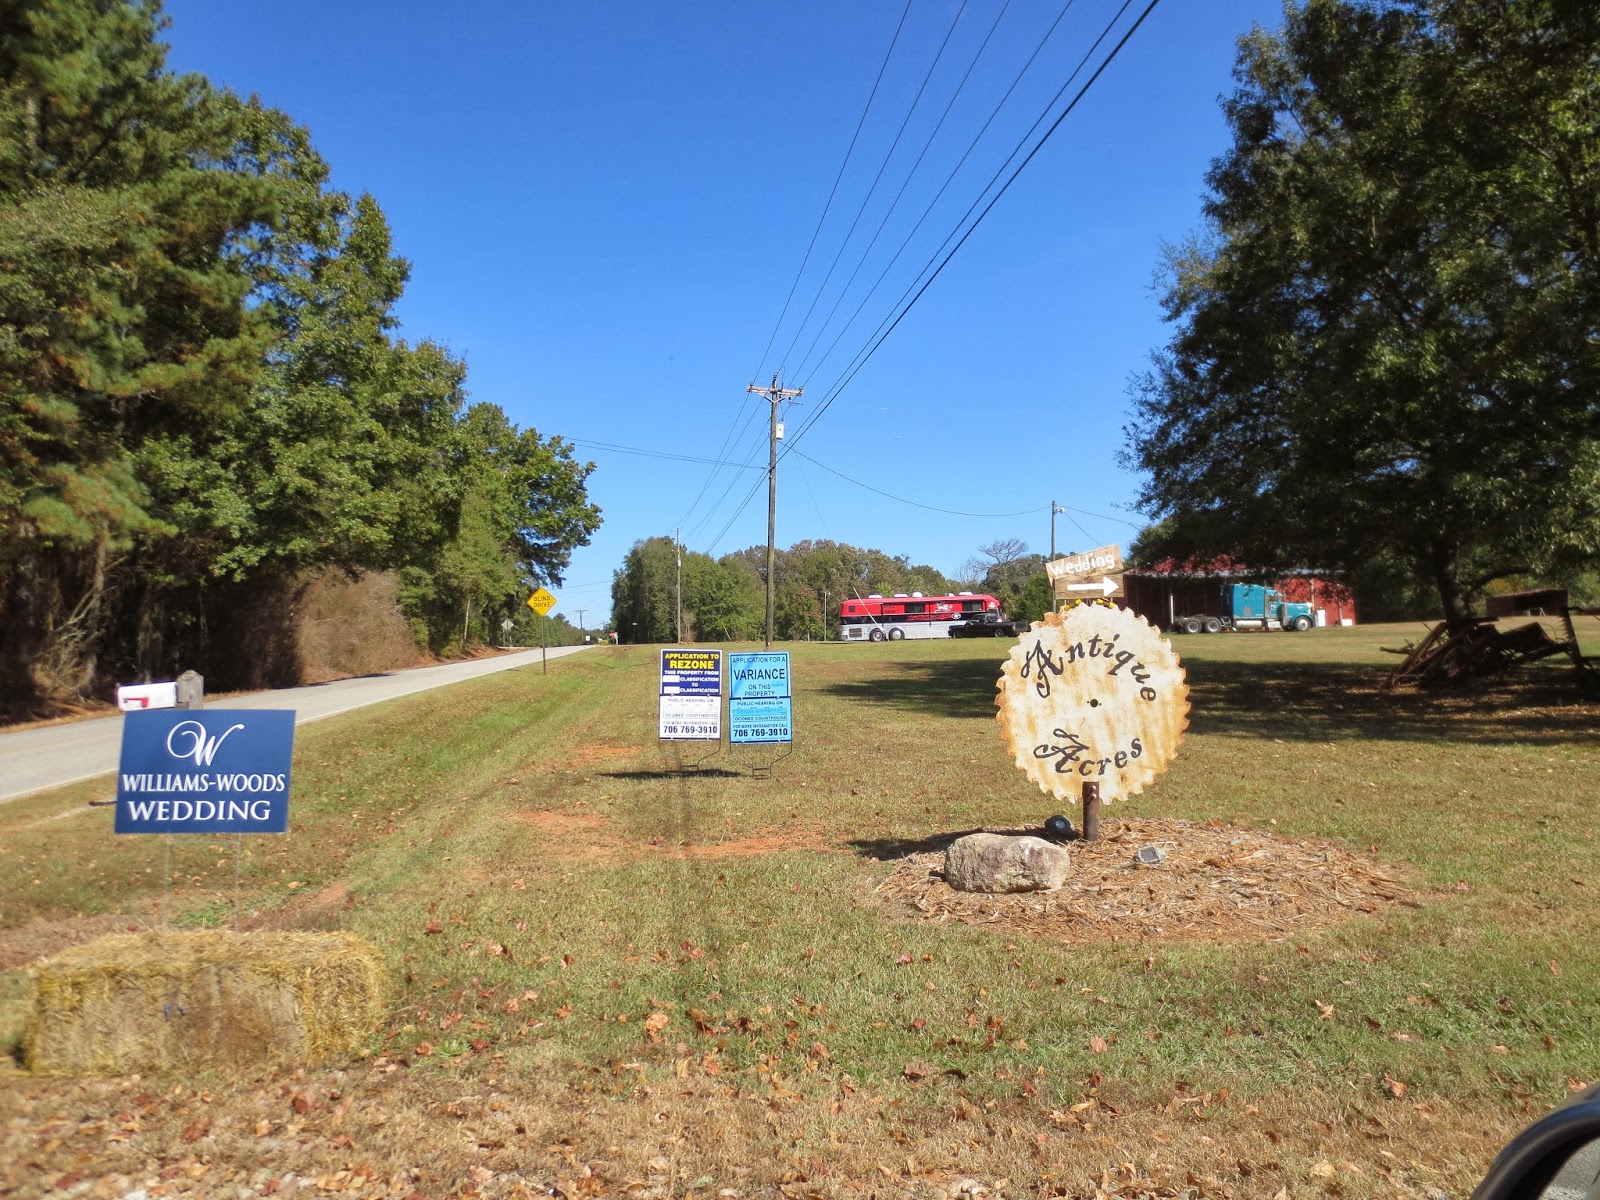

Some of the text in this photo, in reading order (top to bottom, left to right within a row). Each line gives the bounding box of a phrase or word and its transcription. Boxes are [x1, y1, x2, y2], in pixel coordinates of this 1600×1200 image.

[1049, 552, 1115, 577] Wedding
[669, 660, 715, 669] REZONE
[733, 668, 785, 680] VARIANCE
[1020, 633, 1157, 702] Antique
[663, 725, 718, 733] 706 769-3910
[733, 728, 788, 737] 706 769-3910
[1033, 727, 1143, 776] Acres
[122, 773, 286, 792] WILLIAMS-WOODS
[128, 800, 271, 821] WEDDING
